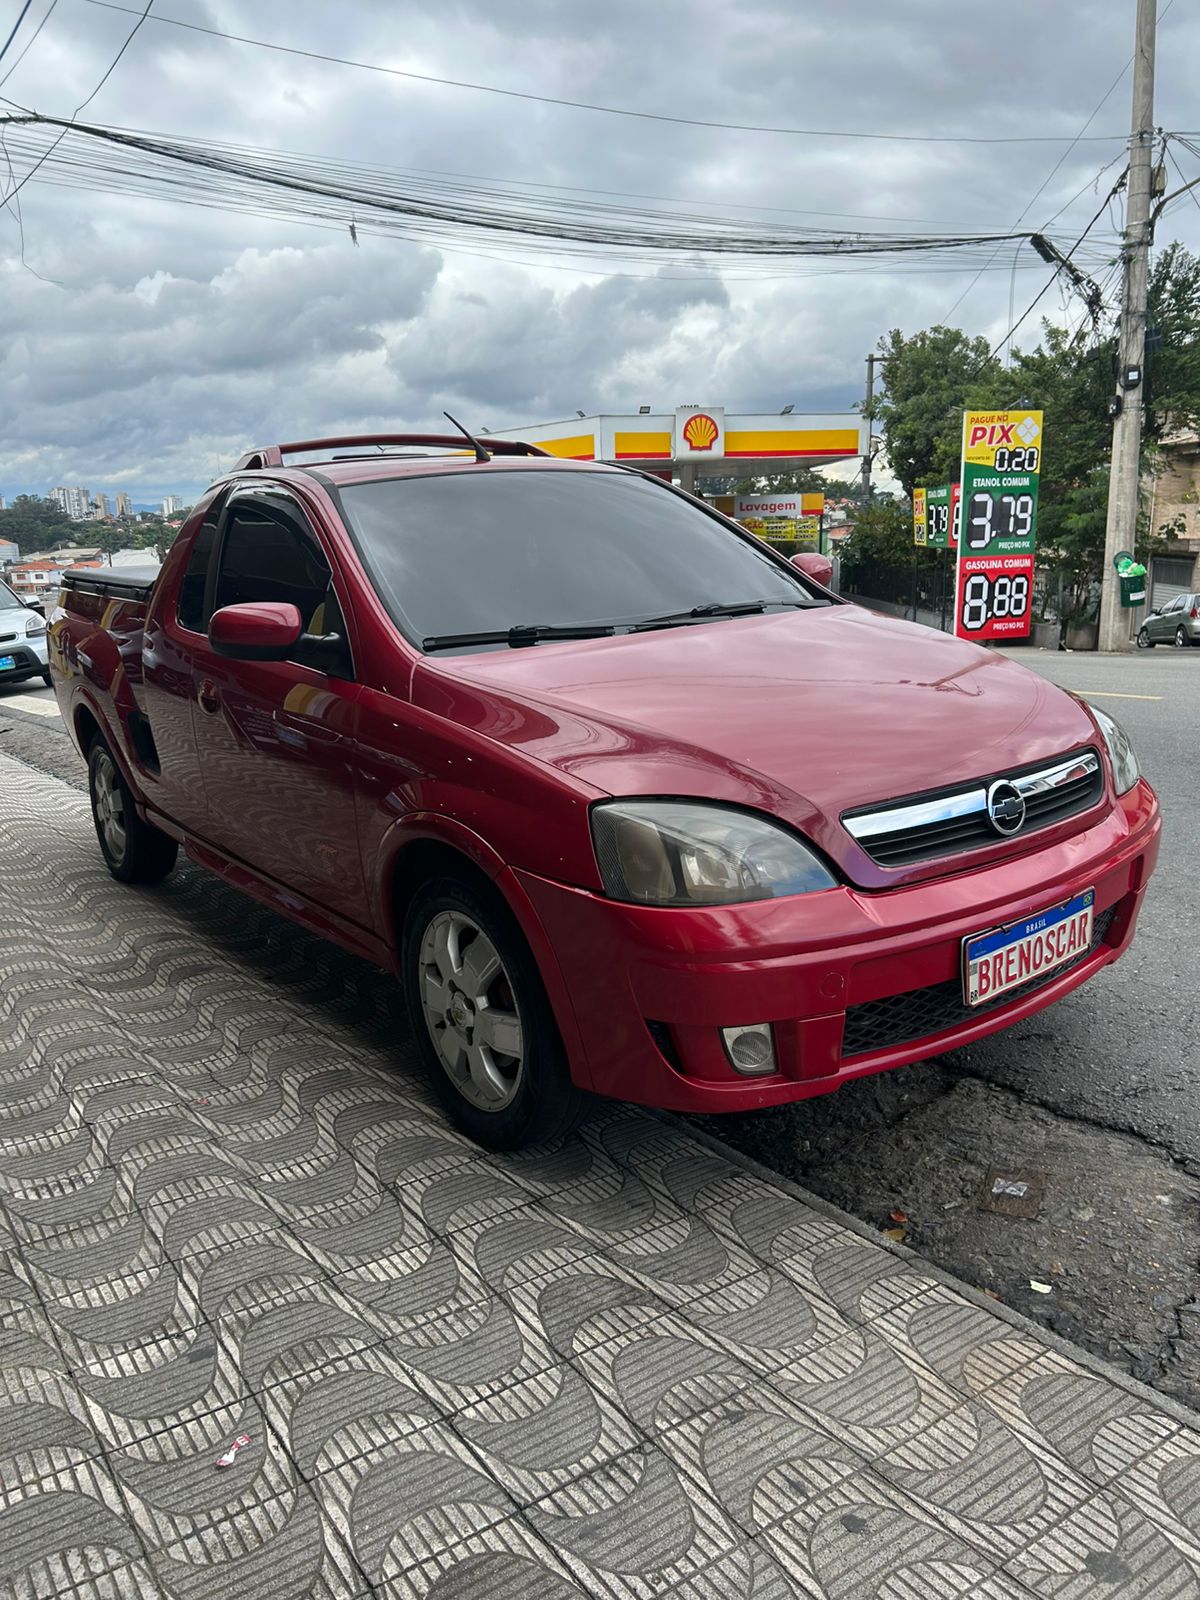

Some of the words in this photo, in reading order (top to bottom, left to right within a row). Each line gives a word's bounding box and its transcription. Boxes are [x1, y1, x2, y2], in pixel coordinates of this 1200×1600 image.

[970, 415, 996, 424] PAGUE
[997, 414, 1009, 422] NO
[969, 423, 1016, 447] PIX
[995, 447, 1038, 472] 0,20
[973, 477, 1001, 487] ETANOL
[1001, 477, 1030, 487] COMUM
[739, 501, 796, 513] Lavagem
[970, 493, 1033, 548] 3,79
[998, 541, 1014, 550] PREÇO
[1014, 541, 1022, 549] NO
[965, 560, 1003, 570] GASOLINA
[1004, 558, 1031, 568] COMUM
[963, 575, 1028, 629] 8,88
[993, 622, 1008, 631] PREÇO
[1025, 918, 1047, 934] BRASIL
[978, 911, 1089, 998] BRENOSCAR
[970, 989, 979, 1003] BR
